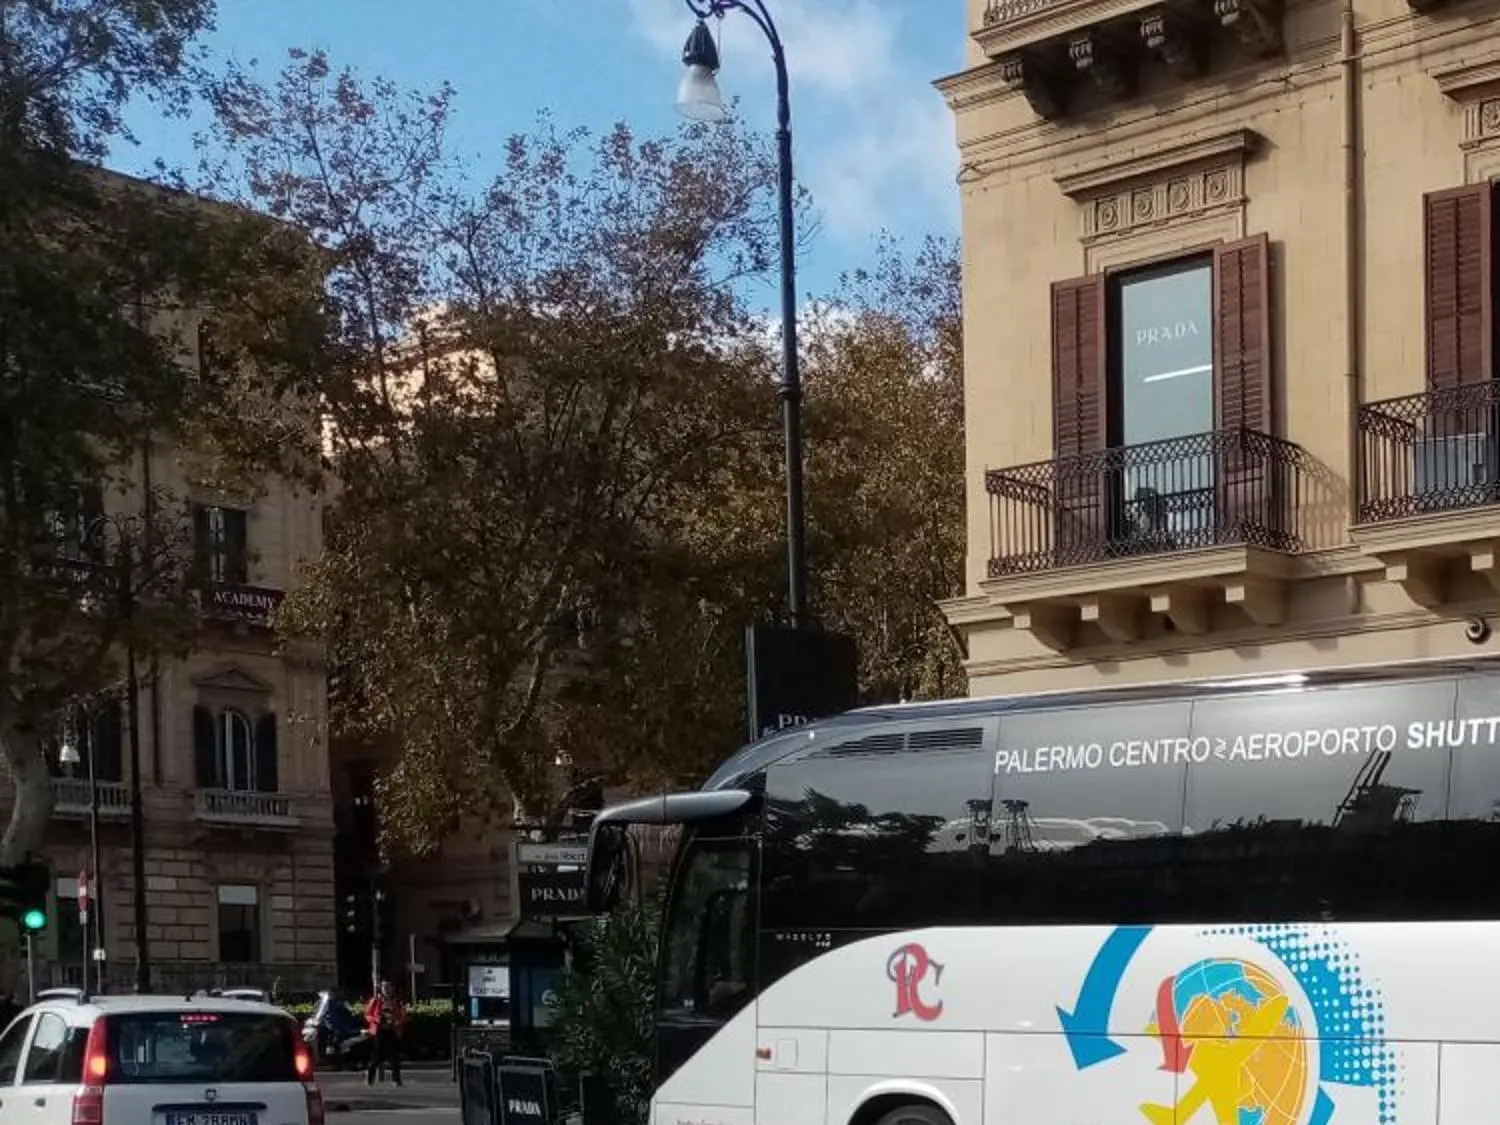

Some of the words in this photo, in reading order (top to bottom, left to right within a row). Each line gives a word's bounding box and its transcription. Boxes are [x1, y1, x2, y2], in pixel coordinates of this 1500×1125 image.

[1136, 319, 1199, 345] PRADA
[213, 591, 276, 609] ACADEMY
[994, 743, 1102, 775] PALERMO
[1108, 736, 1210, 767] CENTRO
[1230, 724, 1397, 760] AEROPORTO
[508, 1099, 541, 1116] PRADA
